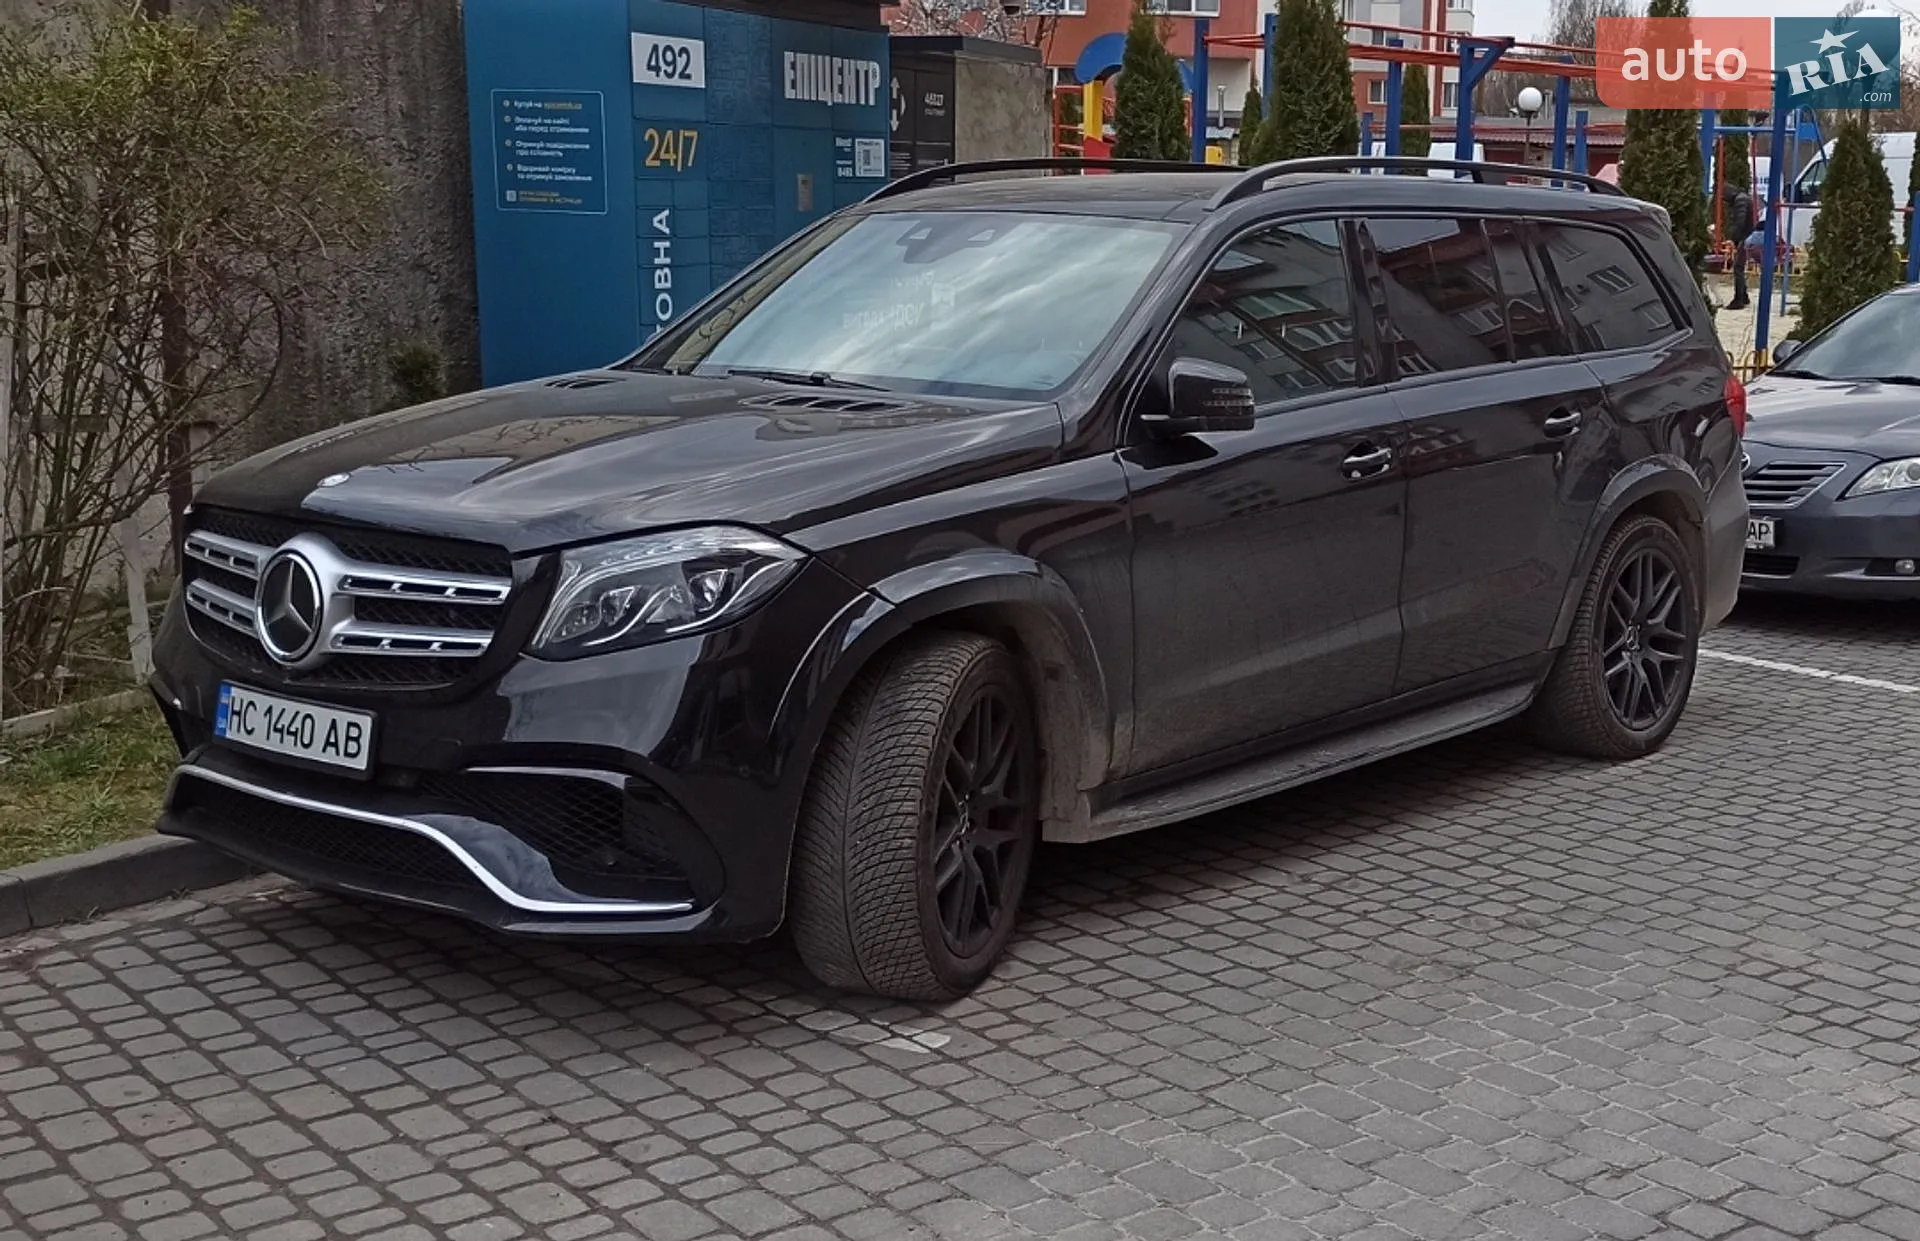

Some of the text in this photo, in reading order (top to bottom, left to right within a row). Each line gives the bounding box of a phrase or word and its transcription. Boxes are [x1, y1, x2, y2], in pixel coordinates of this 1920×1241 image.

[646, 43, 693, 80] 492
[783, 50, 880, 106] ЕПІЦЕНТР
[644, 128, 699, 172] 24/7
[229, 696, 363, 759] HC 1440 AB
